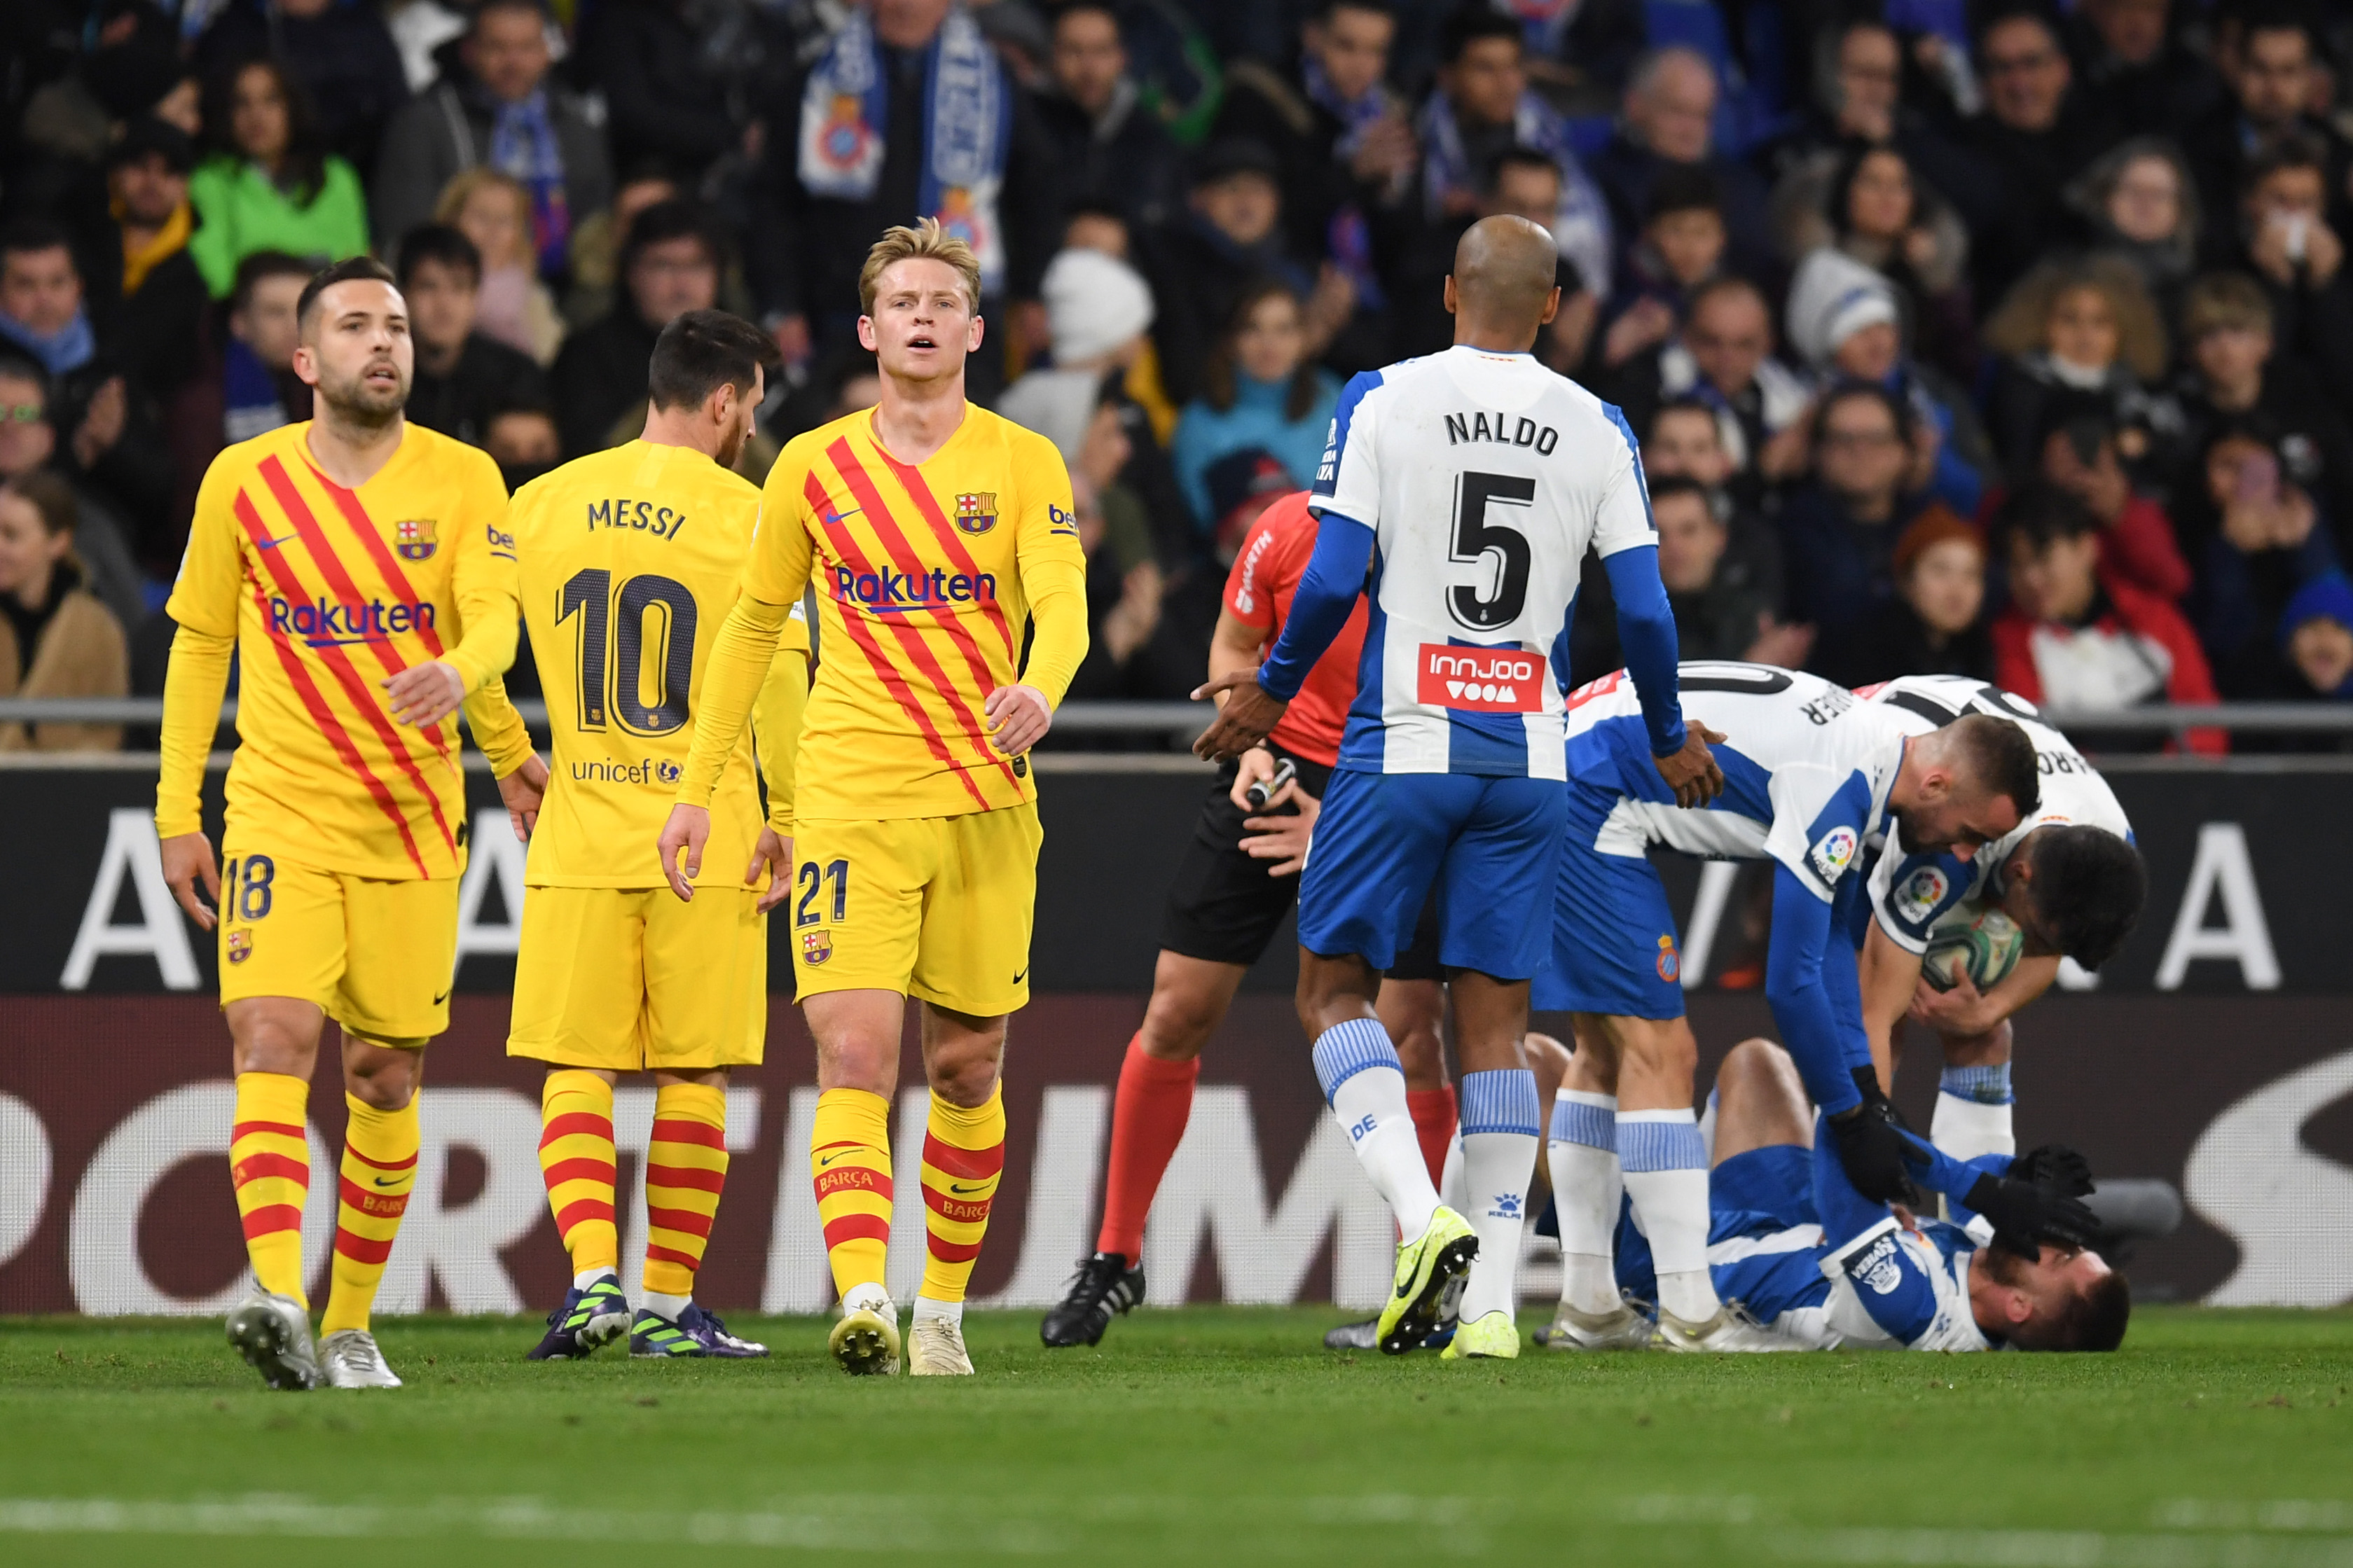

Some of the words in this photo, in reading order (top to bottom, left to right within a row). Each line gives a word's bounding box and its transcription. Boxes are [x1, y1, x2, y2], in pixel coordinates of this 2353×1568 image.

[1444, 412, 1559, 457] NALDO
[587, 499, 686, 542] MESSI
[1444, 470, 1536, 632] 5
[838, 564, 996, 604] Rakuten
[270, 596, 435, 634] Rakuten
[555, 568, 698, 738] 10
[572, 756, 651, 784] unicef
[225, 854, 275, 924] 18
[795, 859, 849, 930] 21
[819, 1171, 874, 1193] BARÇA
